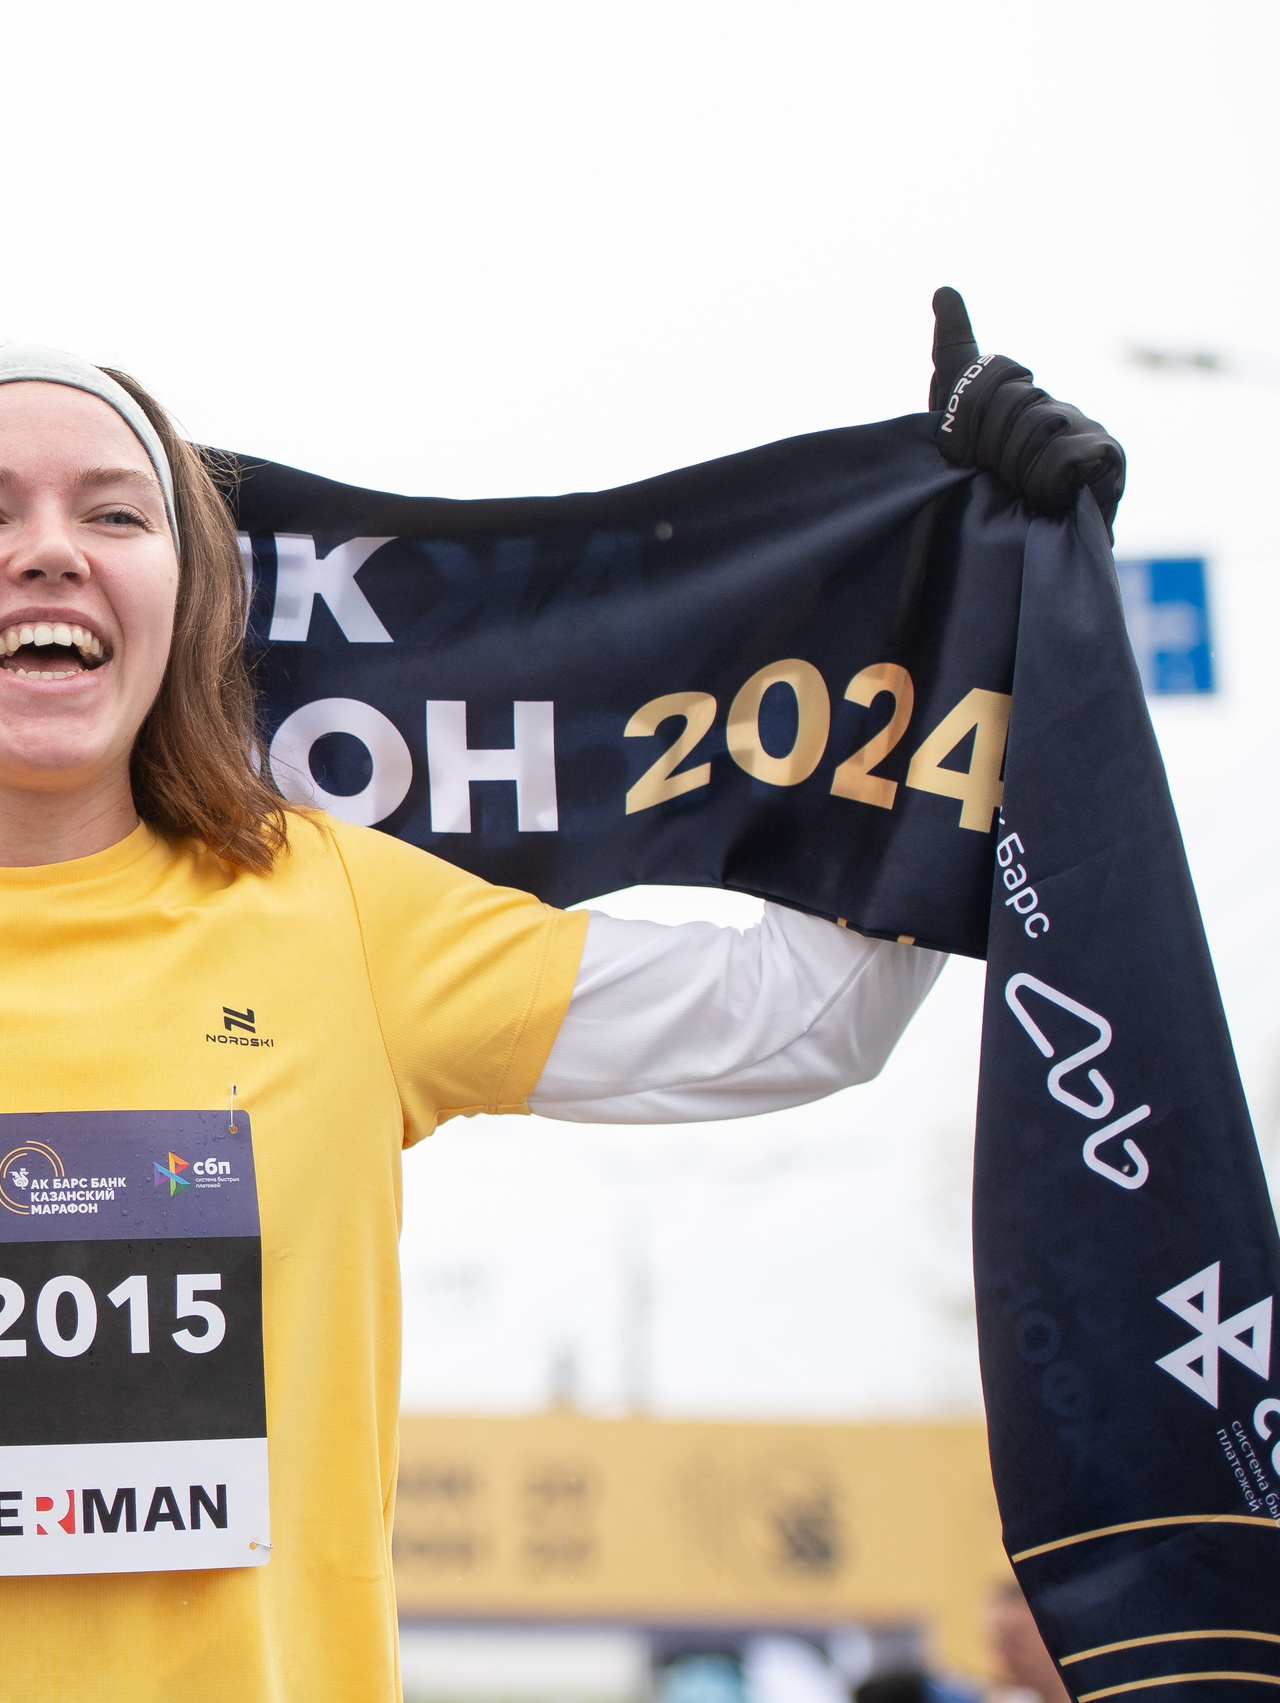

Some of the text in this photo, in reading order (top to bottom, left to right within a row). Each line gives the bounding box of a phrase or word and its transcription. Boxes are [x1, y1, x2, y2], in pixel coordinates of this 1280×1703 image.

[941, 354, 995, 433] NORDS
[623, 658, 1011, 834] 2024
[997, 832, 1050, 939] Барс
[206, 1033, 274, 1048] NORDSKI
[30, 1177, 127, 1190] АК БАРС БАНК
[193, 1157, 231, 1175] сбп
[30, 1187, 115, 1203] КАЗАНСКИЙ
[30, 1203, 98, 1216] МАРАФОН
[1216, 1428, 1263, 1512] платежей
[1231, 1420, 1269, 1492] система
